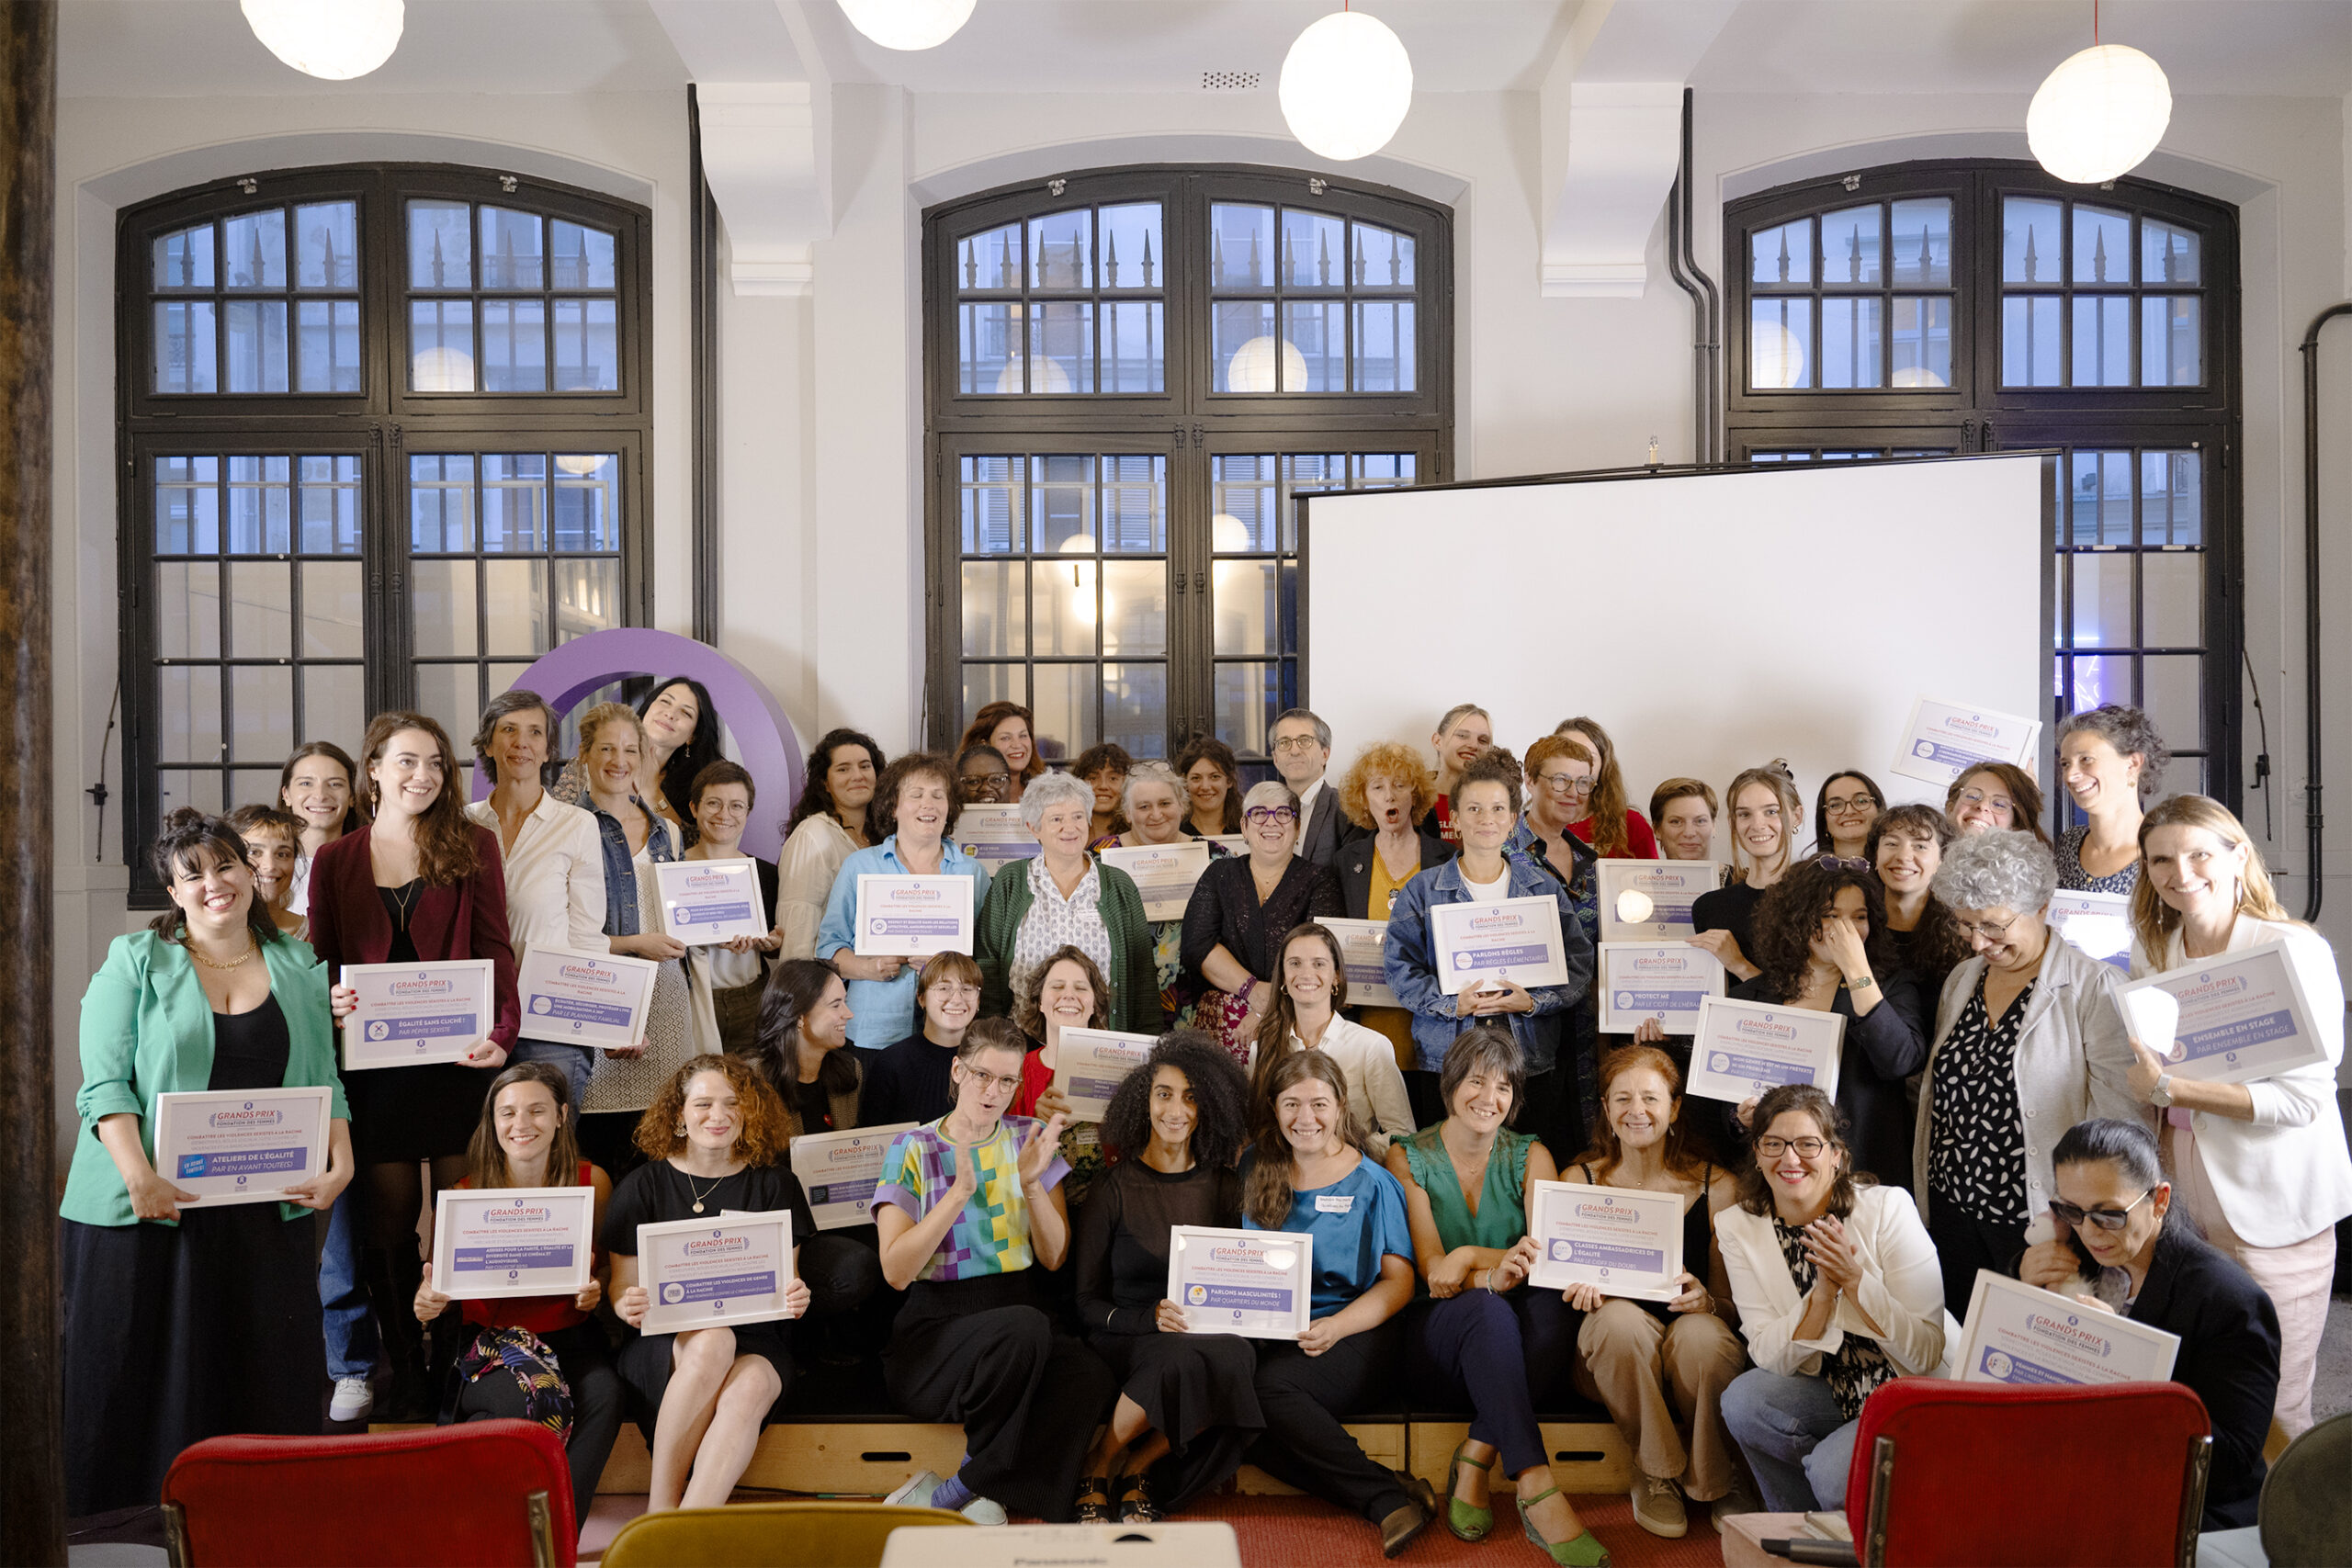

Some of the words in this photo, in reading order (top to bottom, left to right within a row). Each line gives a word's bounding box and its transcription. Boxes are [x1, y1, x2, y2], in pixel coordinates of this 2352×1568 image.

[1952, 717, 1978, 728] GRANDS
[1507, 955, 1547, 963] ÉLÉMENTAIRES
[566, 965, 594, 975] GRANDS
[2178, 983, 2215, 999] GRANDS
[2216, 978, 2237, 990] PRIX
[2180, 995, 2210, 1006] FONDATION
[2222, 987, 2240, 996] FEMMES
[1743, 1020, 1773, 1029] GRANDS
[2193, 1027, 2234, 1044] ENSEMBLE
[2236, 1024, 2248, 1033] EN
[2250, 1017, 2275, 1030] STAGE
[2197, 1043, 2211, 1054] PAR
[2213, 1034, 2251, 1050] ENSEMBLE
[2254, 1031, 2264, 1040] EN
[2265, 1025, 2290, 1038] STAGE
[218, 1111, 254, 1119] GRANDS
[212, 1155, 247, 1163] ATELIERS
[260, 1151, 294, 1160] L'ÉGALITÉ
[1582, 1205, 1613, 1213] GRANDS
[691, 1239, 723, 1248] GRANDS
[1599, 1245, 1645, 1254] AMBASSADRICES
[2036, 1315, 2077, 1338] GRANDS
[2079, 1331, 2103, 1347] PRIX
[2034, 1326, 2065, 1341] FONDATION
[2079, 1342, 2100, 1354] FEMMES
[2015, 1361, 2037, 1374] FEMMES
